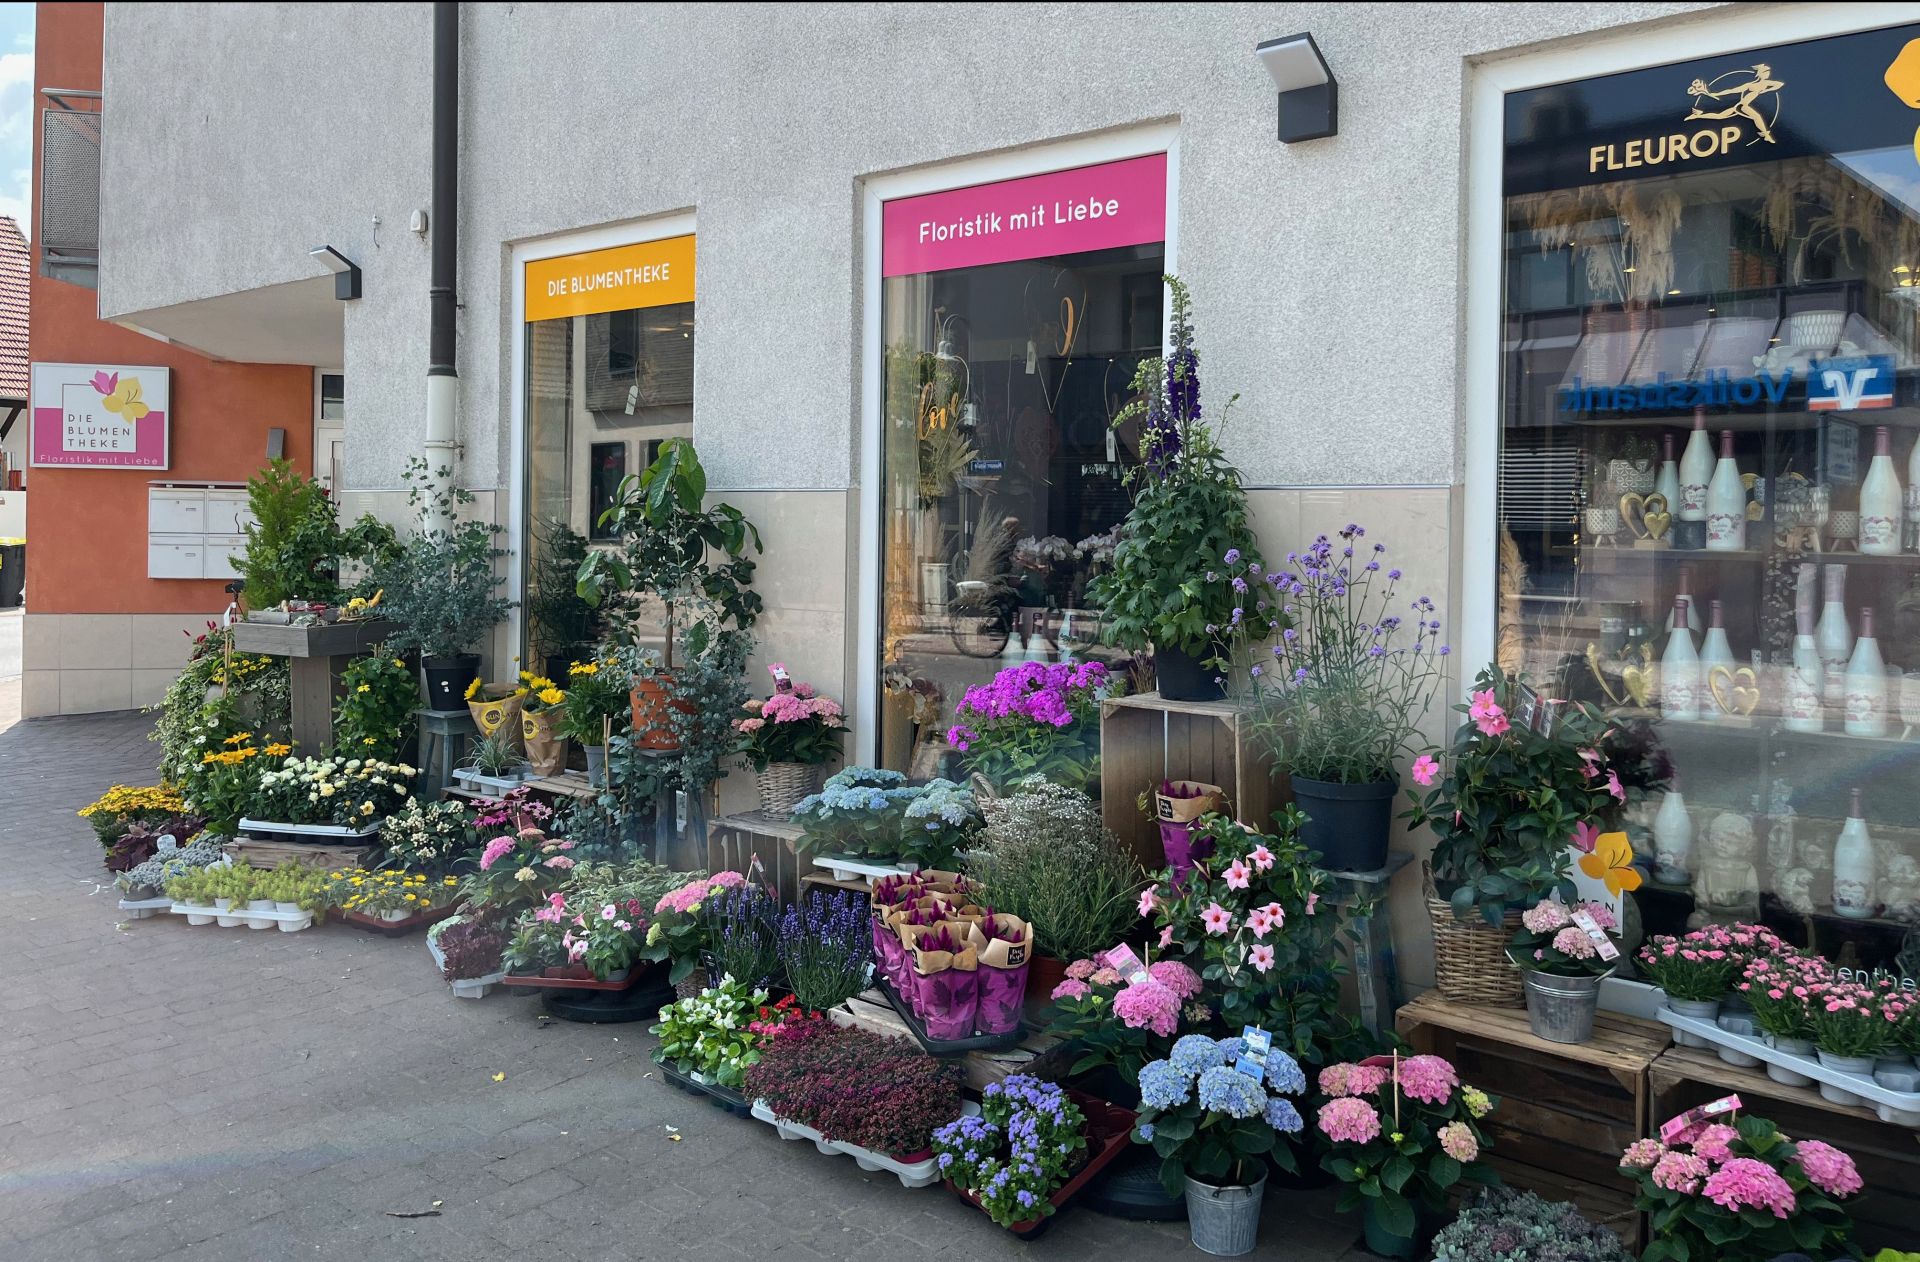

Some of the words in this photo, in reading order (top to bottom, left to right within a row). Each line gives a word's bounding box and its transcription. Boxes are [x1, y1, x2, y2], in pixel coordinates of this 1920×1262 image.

[1589, 126, 1741, 173] FLEUROP
[919, 211, 1002, 244] Floristik
[1009, 204, 1045, 231] mit
[1054, 196, 1119, 225] Liebe
[548, 279, 567, 296] DIE
[571, 263, 670, 293] BLUMENTHEKE
[68, 414, 93, 423] DIE
[68, 426, 130, 436] BLUMEN
[68, 439, 119, 448] THEKE
[40, 454, 93, 464] Floristik
[98, 457, 119, 465] mit
[124, 456, 159, 465] Liebe
[1831, 966, 1916, 992] enthe
